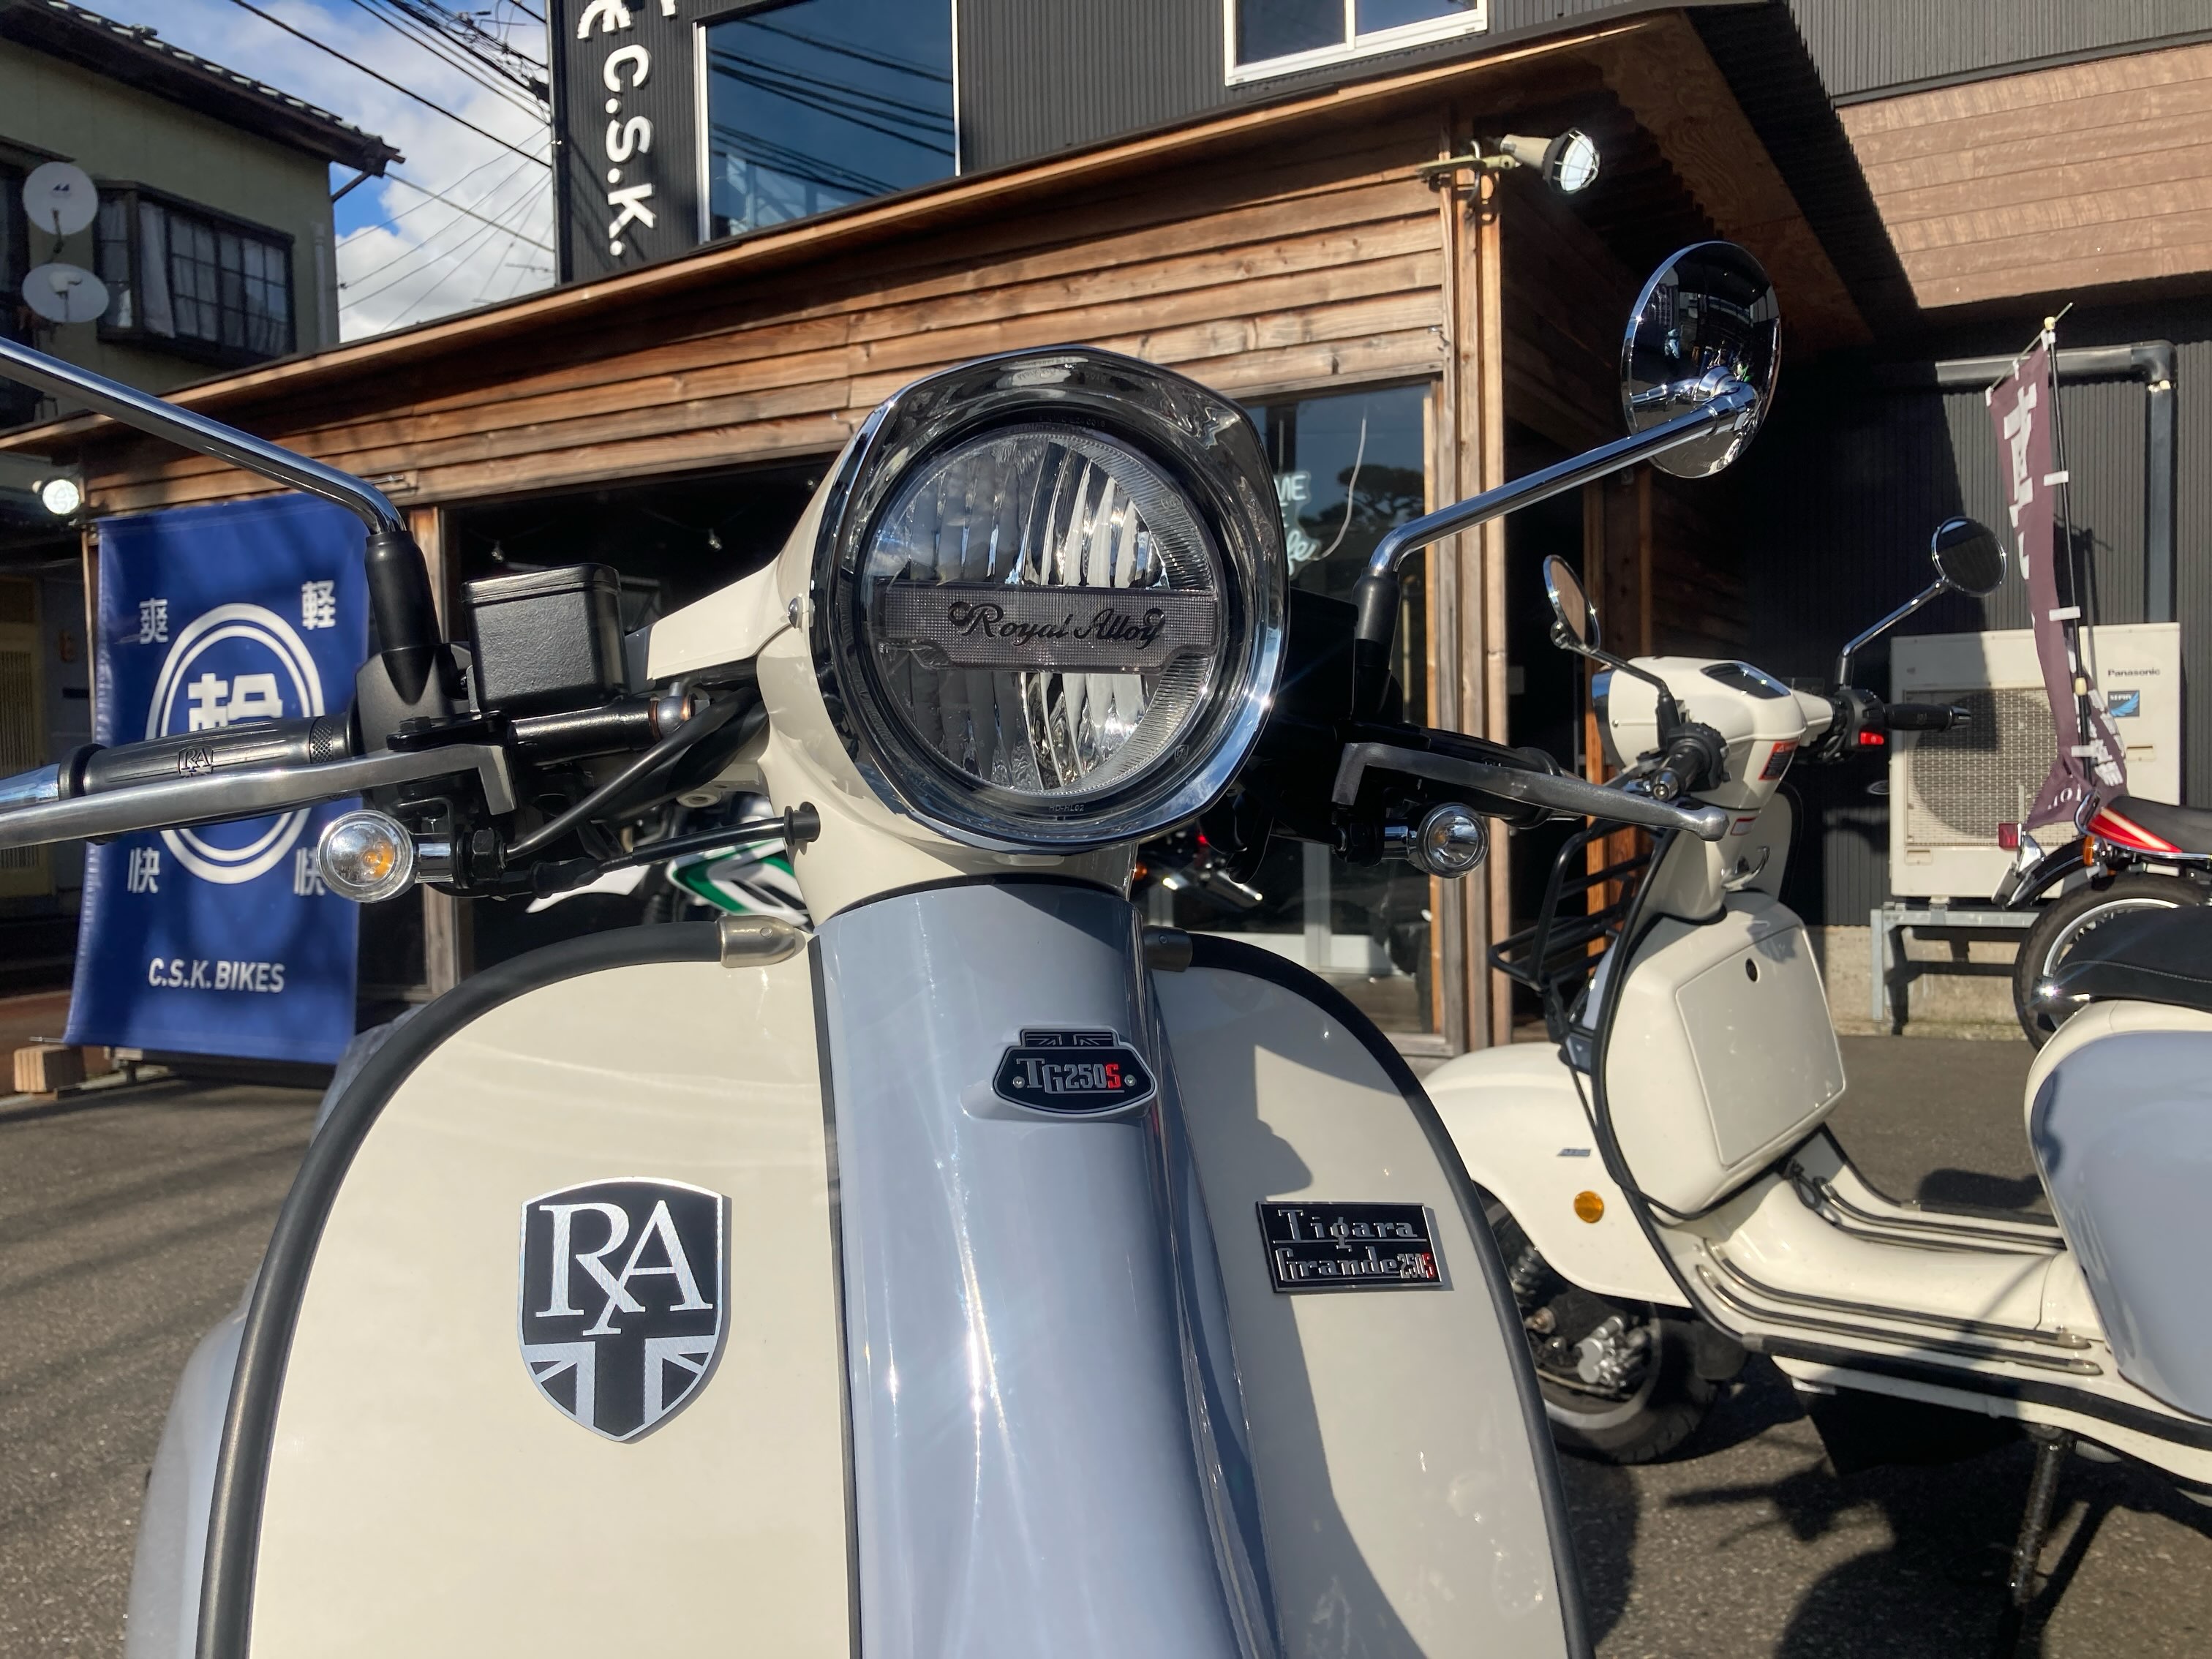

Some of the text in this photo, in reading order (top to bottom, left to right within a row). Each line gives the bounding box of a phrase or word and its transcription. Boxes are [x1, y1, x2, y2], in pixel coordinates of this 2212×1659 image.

[949, 601, 1165, 650] Royal Alloy
[2107, 667, 2160, 677] Panasonic
[214, 960, 285, 993] BIKES
[1278, 1209, 1419, 1252] Tigara
[535, 1200, 713, 1336] RA
